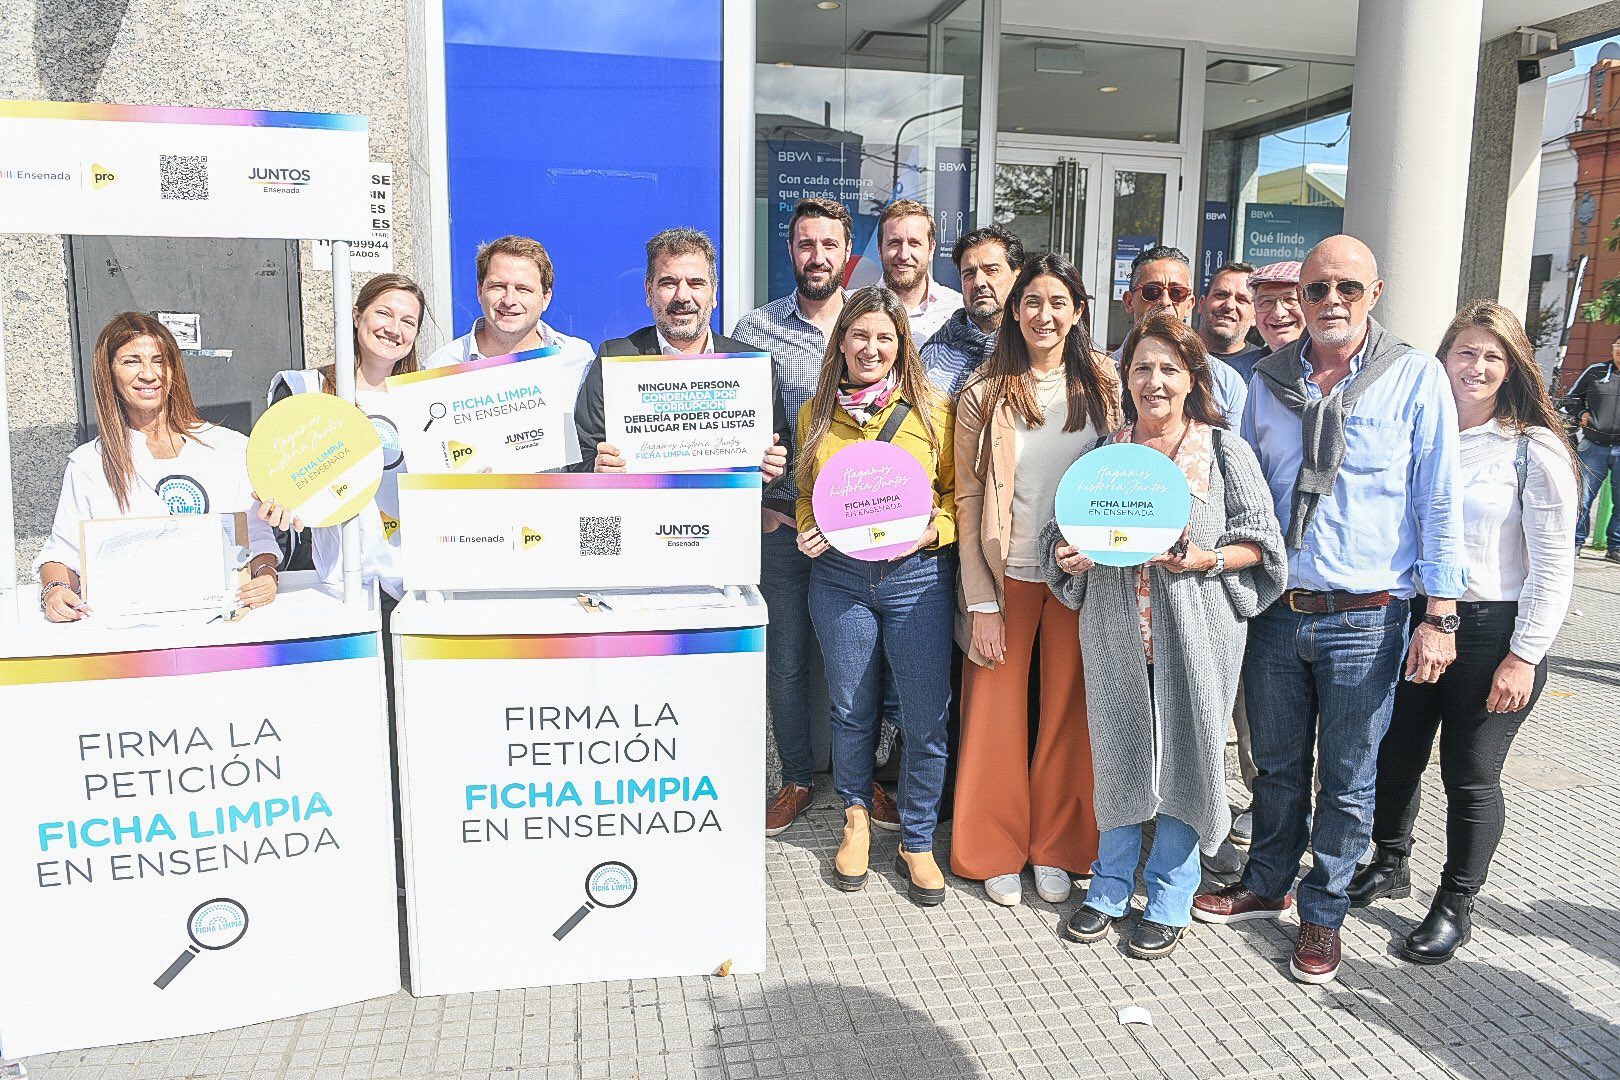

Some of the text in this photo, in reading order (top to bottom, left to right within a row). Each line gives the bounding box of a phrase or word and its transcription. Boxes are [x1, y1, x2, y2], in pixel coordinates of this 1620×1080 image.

[778, 151, 812, 162] BBVA
[248, 167, 311, 182] JUNTOS
[939, 162, 967, 172] BBVA
[17, 170, 71, 181] Ensenada
[94, 173, 115, 184] pro
[778, 173, 874, 189] Con cada compra
[263, 186, 300, 194] Ensenada
[778, 188, 875, 201] que hacés, sumás
[1205, 212, 1227, 220] BBVA
[1250, 210, 1274, 219] BBVA
[1250, 230, 1305, 245] Qué lindo
[1249, 246, 1305, 258] cuando la
[637, 380, 740, 392] NINGUNA PERSONA
[452, 385, 542, 412] FICHA LIMPIA
[642, 390, 736, 403] CONDENADA POR
[453, 397, 547, 424] EN ENSENADA
[623, 409, 756, 424] DEBERÍA PODER OCUPAR
[625, 419, 755, 434] UN LUGAR EN LAS LISTAS
[504, 428, 545, 444] JUNTOS
[291, 441, 346, 481] FICHA LIMPIA
[452, 447, 473, 461] pro
[635, 447, 748, 460] FICHA LIMPIA EN ENSENADA
[296, 448, 351, 490] EN ENSENADA
[843, 466, 894, 486] Hagamos
[1096, 465, 1152, 484] Hagamos
[336, 484, 348, 496] pro
[829, 472, 911, 497] historia Juntos
[1077, 479, 1169, 496] historia Juntos
[844, 494, 901, 511] FICHA LIMPIA
[858, 502, 903, 516] ENSENADA
[1090, 500, 1154, 509] FICHA LIMPIA
[1103, 509, 1155, 517] ENSENADA
[655, 524, 710, 536] JUNTOS
[873, 532, 886, 540] pro
[459, 534, 505, 543] Ensenada
[524, 534, 542, 544] pro
[505, 702, 679, 731] FIRMA LA
[78, 718, 282, 761] FIRMA LA
[508, 733, 676, 767] PETICIÓN
[85, 753, 281, 801] PETICIÓN
[465, 775, 719, 811] FICHA LIMPIA
[38, 791, 333, 852] FICHA LIMPIA
[462, 809, 722, 843] EN ENSENADA
[37, 827, 340, 888] EN ENSENADA
[195, 920, 243, 934] FICHA LIMPIA
